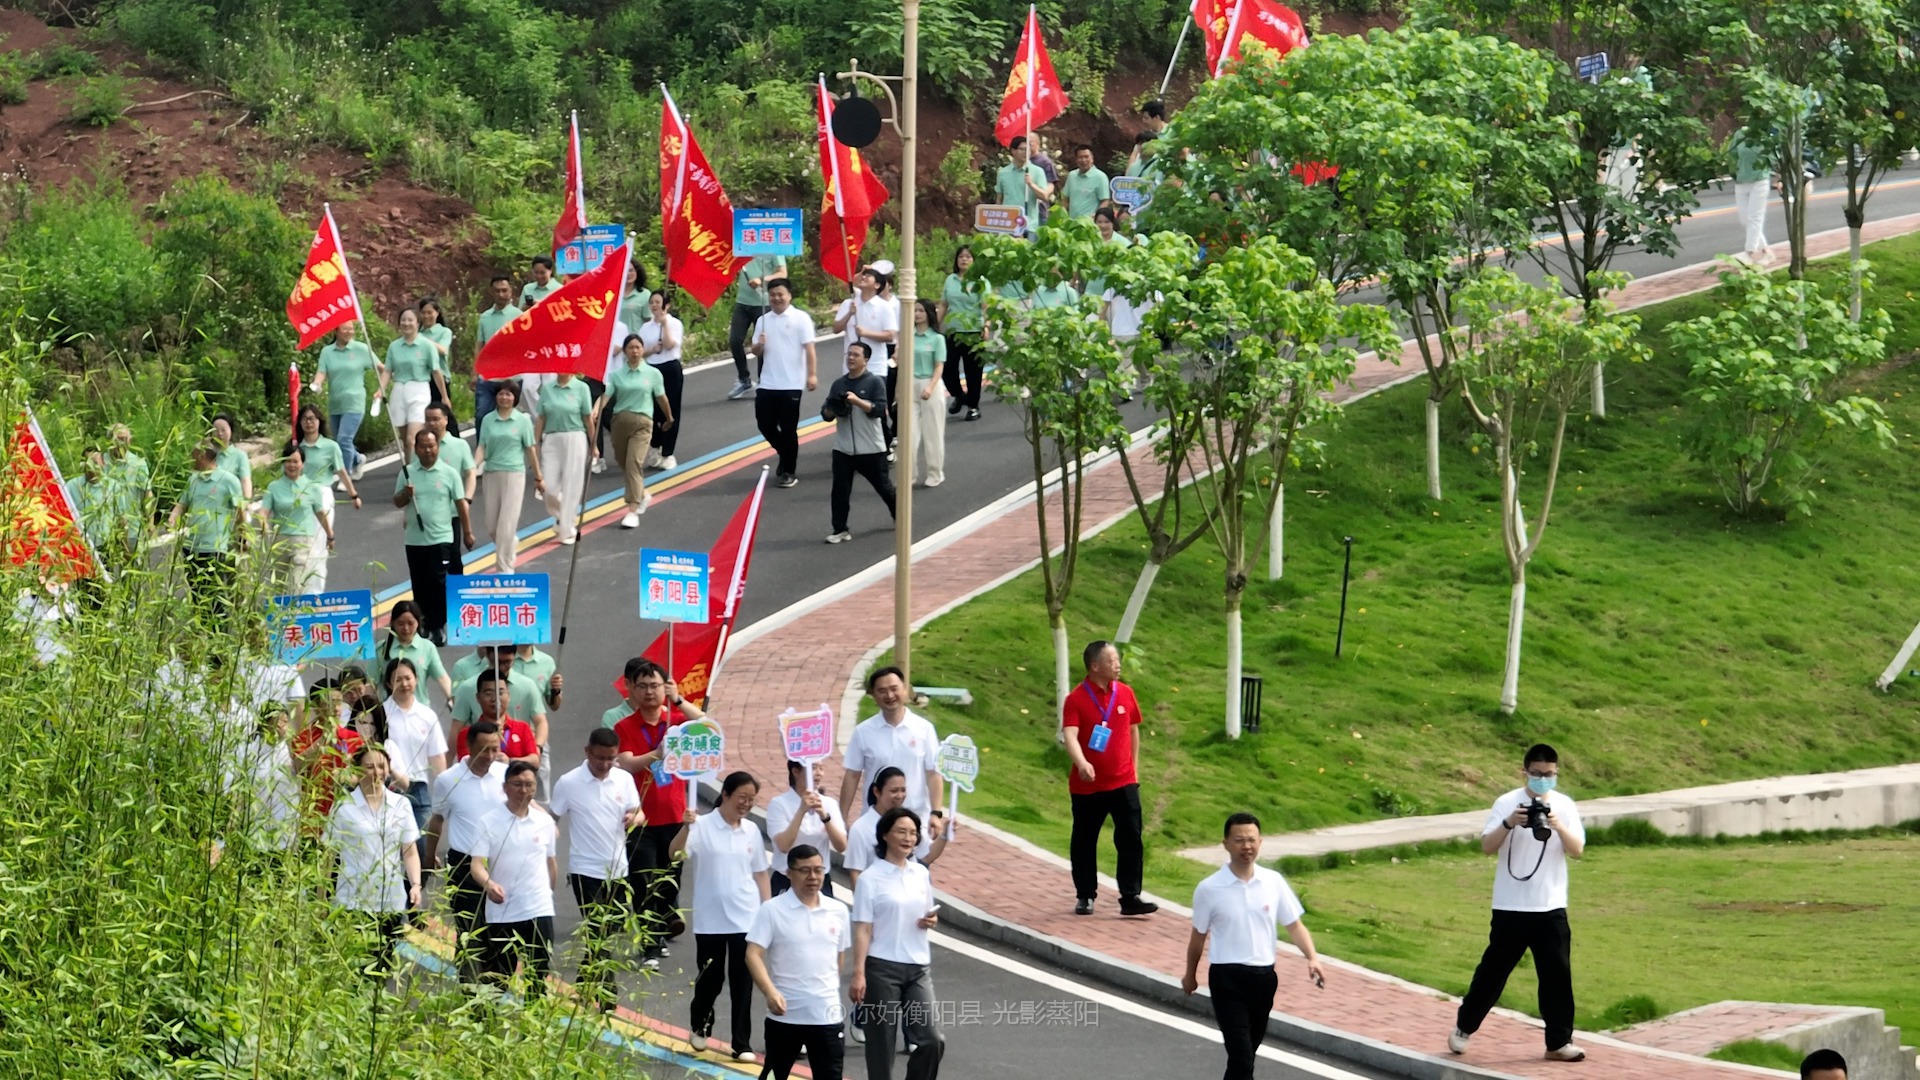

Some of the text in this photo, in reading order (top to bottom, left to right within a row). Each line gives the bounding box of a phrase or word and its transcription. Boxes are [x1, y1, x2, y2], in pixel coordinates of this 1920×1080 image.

[742, 227, 793, 245] 珠晖区
[648, 577, 700, 605] 衡阳县
[460, 602, 538, 628] 衡阳市
[283, 620, 360, 648] 耒阳市
[666, 734, 721, 751] 平衡膳食
[666, 754, 721, 771] 总量控制
